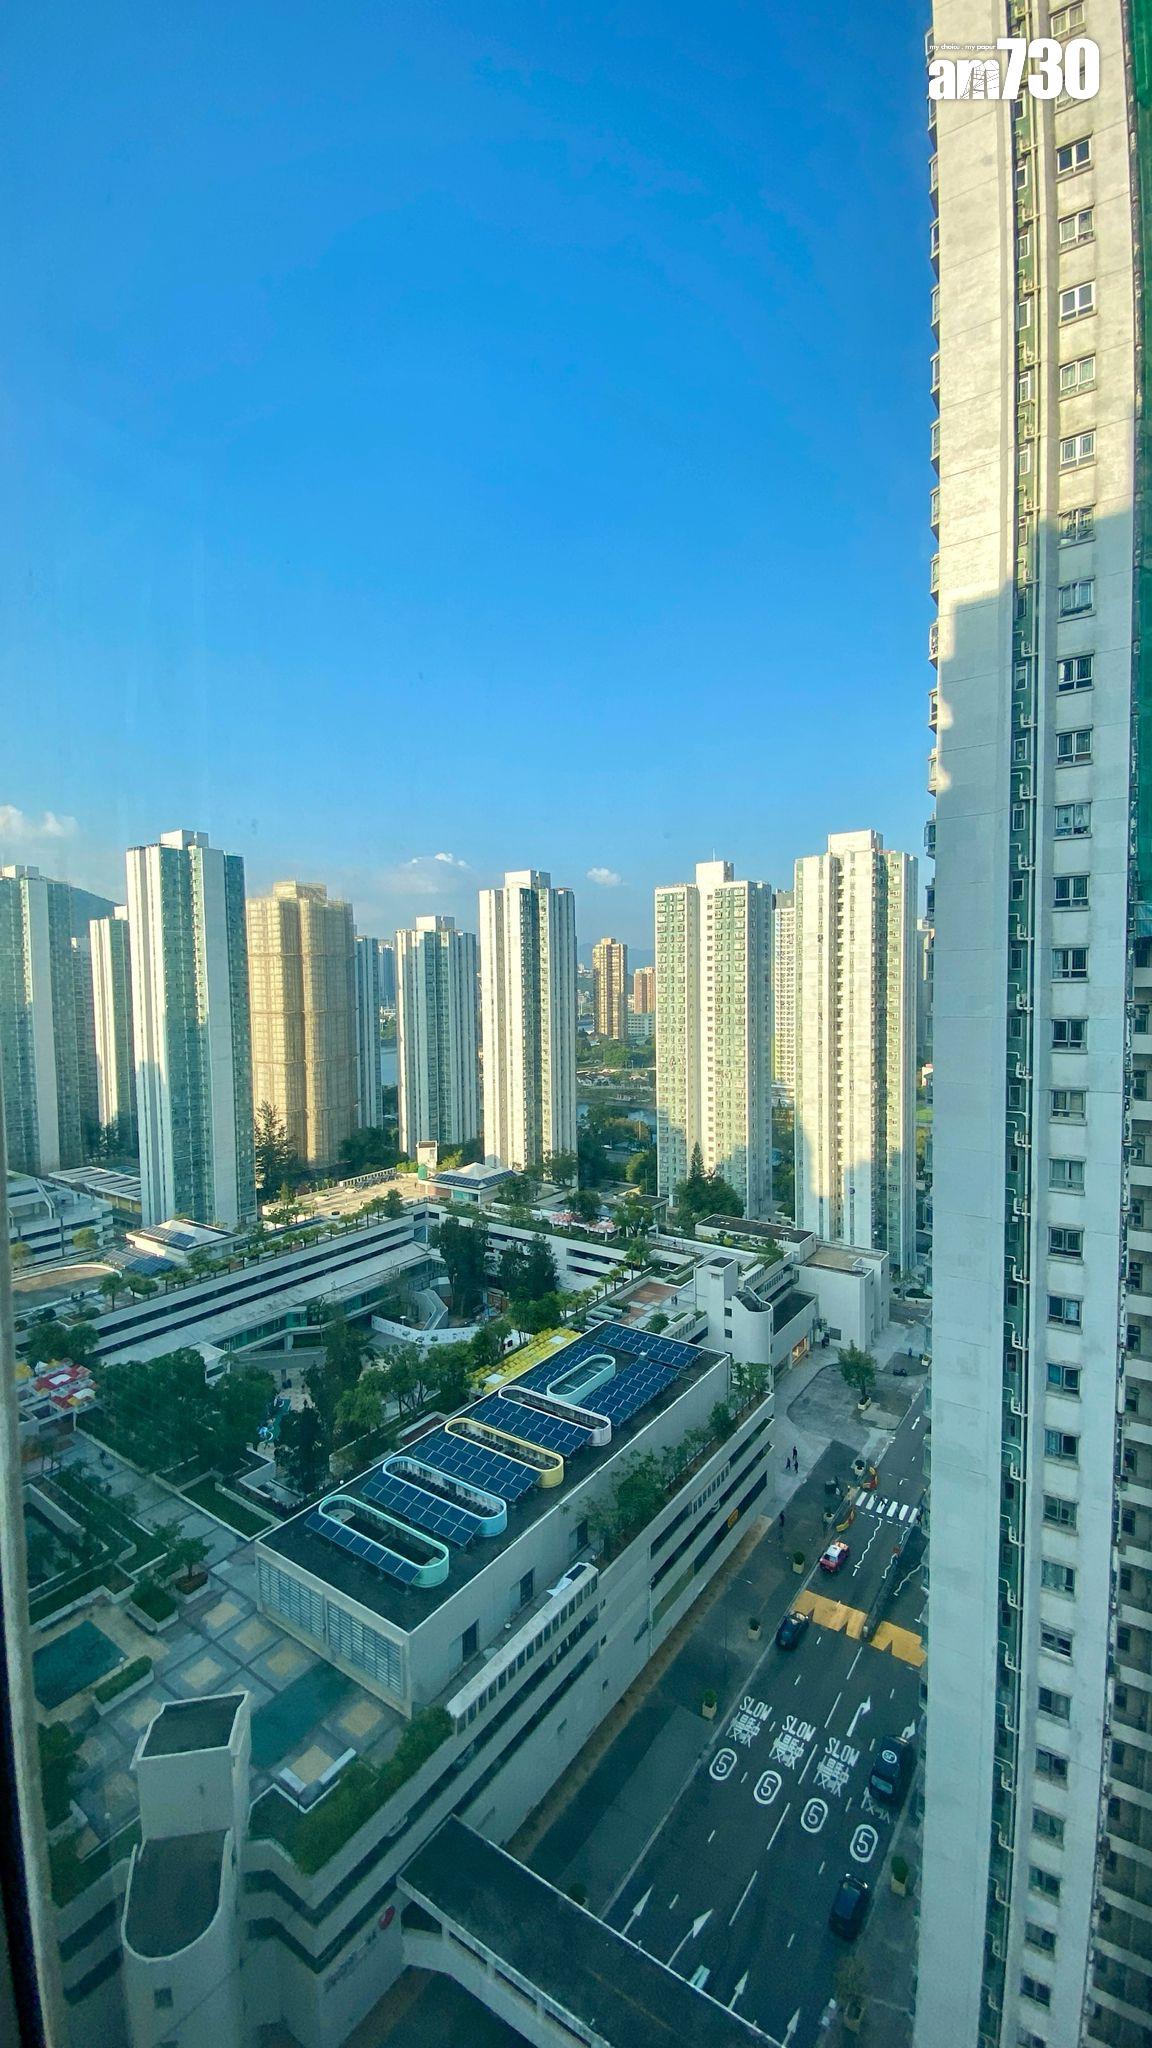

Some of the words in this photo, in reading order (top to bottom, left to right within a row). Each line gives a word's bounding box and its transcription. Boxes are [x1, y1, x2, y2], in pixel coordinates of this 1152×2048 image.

[739, 1695, 773, 1721] SLOW
[781, 1715, 816, 1742] SLOW
[715, 1753, 732, 1773] 5
[824, 1737, 860, 1767] SLOW
[760, 1776, 777, 1796] 5
[807, 1804, 823, 1825] 5
[856, 1831, 873, 1853] 5
